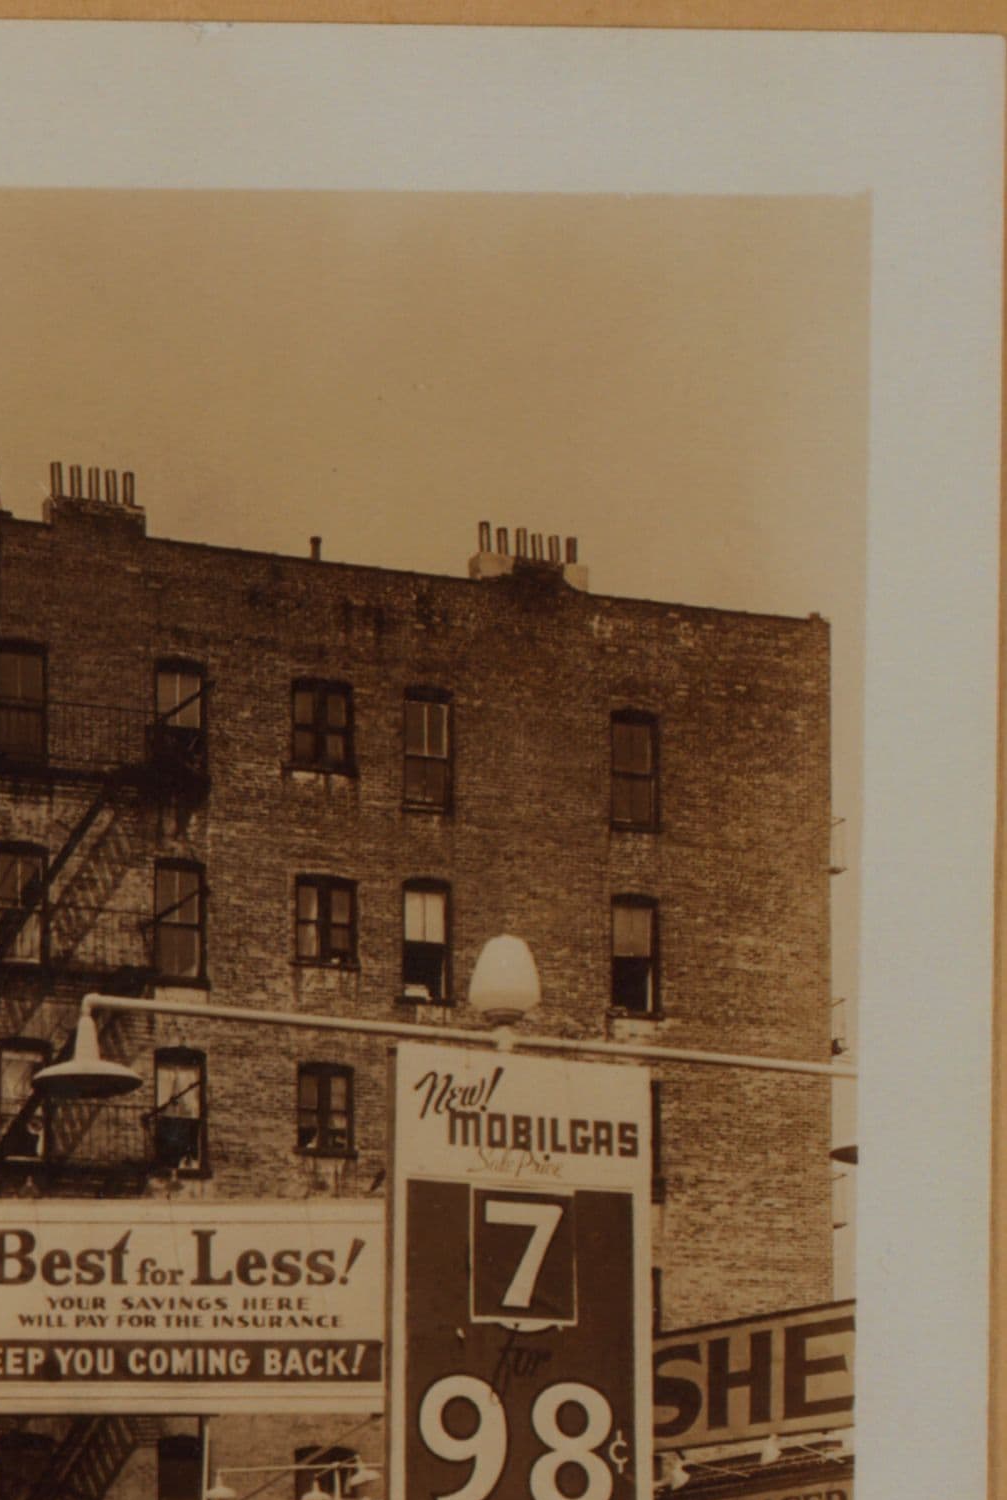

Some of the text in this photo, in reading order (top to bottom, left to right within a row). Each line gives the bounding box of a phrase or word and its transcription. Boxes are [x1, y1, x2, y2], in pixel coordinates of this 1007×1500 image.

[414, 1066, 505, 1119] New!
[448, 1110, 639, 1158] MOBILGAS
[137, 1258, 183, 1286] for
[191, 1229, 366, 1286] Less!
[485, 1200, 564, 1308] 7
[18, 1314, 344, 1328] WILL PAY FOR THE INSURANCE
[46, 1297, 310, 1311] YOUR SAVINGS HERE
[54, 1348, 115, 1375] YOU
[128, 1348, 251, 1376] COMING
[263, 1344, 366, 1376] BACK!
